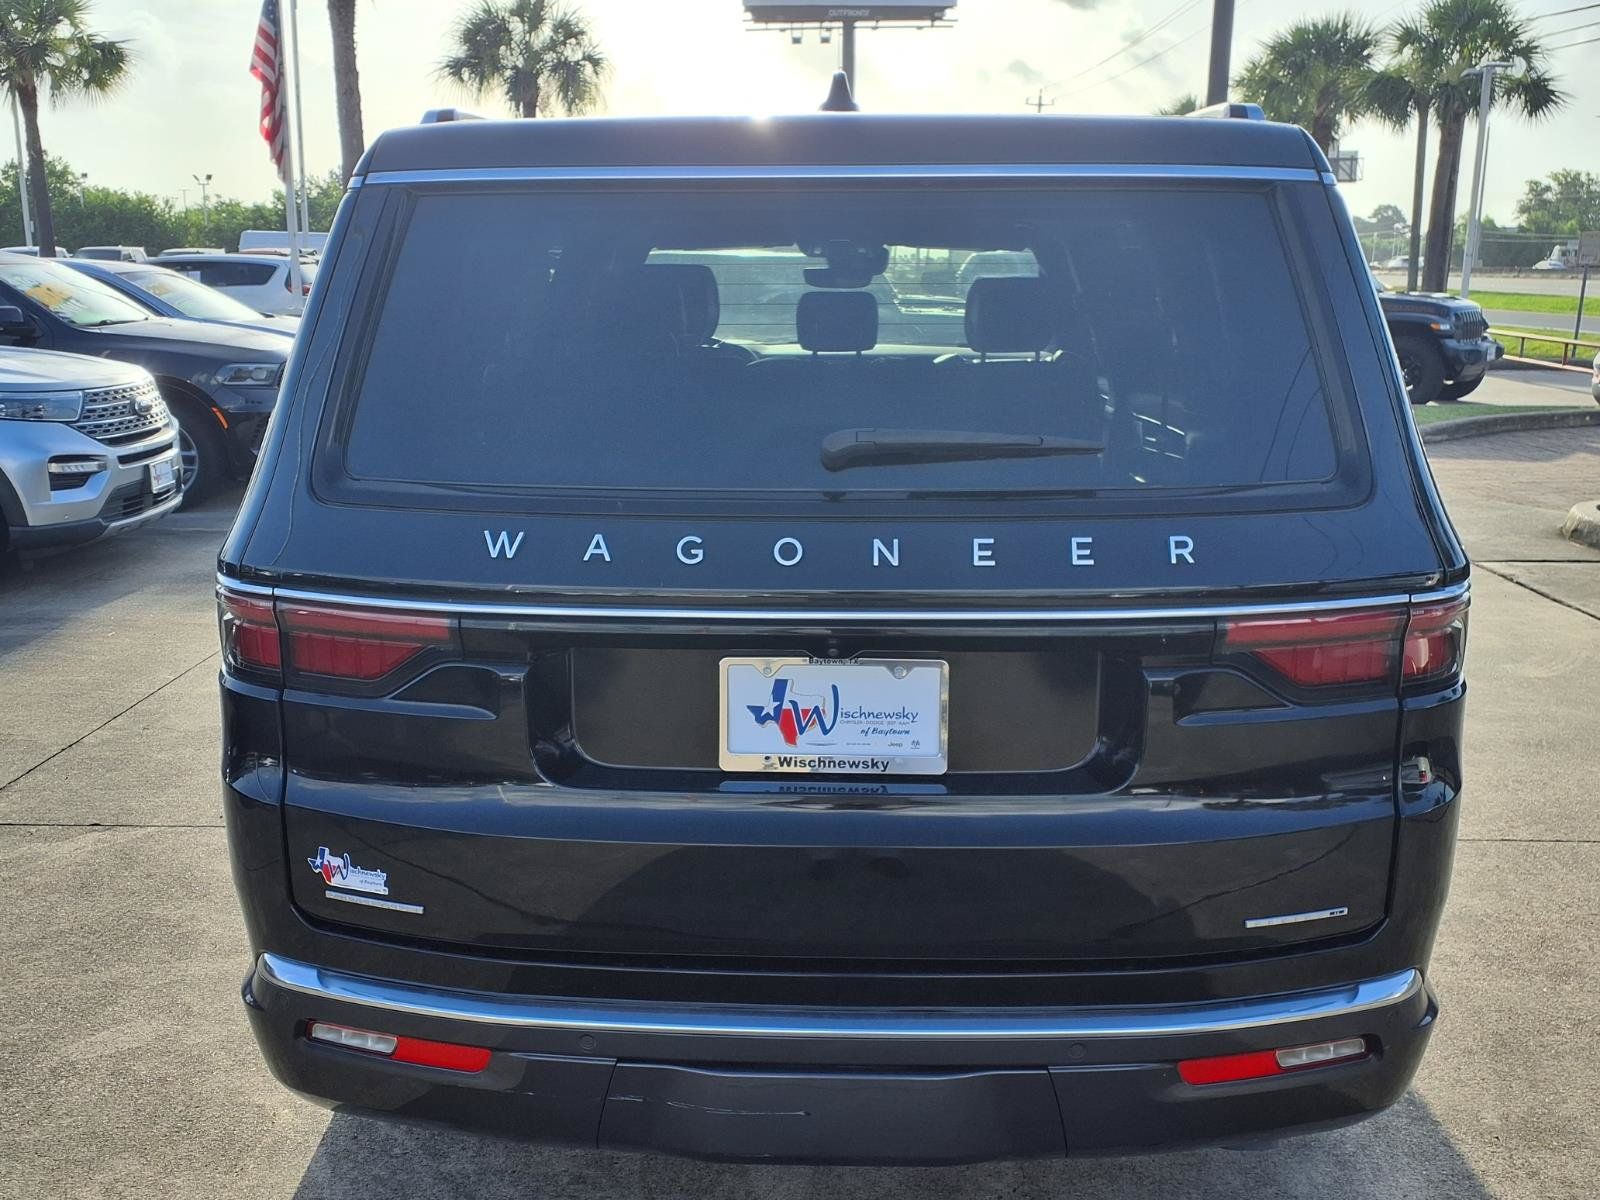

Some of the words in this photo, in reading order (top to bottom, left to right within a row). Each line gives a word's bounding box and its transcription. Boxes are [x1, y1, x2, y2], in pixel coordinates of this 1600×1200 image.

[483, 530, 1196, 567] WAGONEER
[788, 684, 920, 735] Wischnewsky
[860, 727, 871, 737] of
[871, 727, 911, 737] Baytown
[778, 756, 890, 772] Wischnewsky
